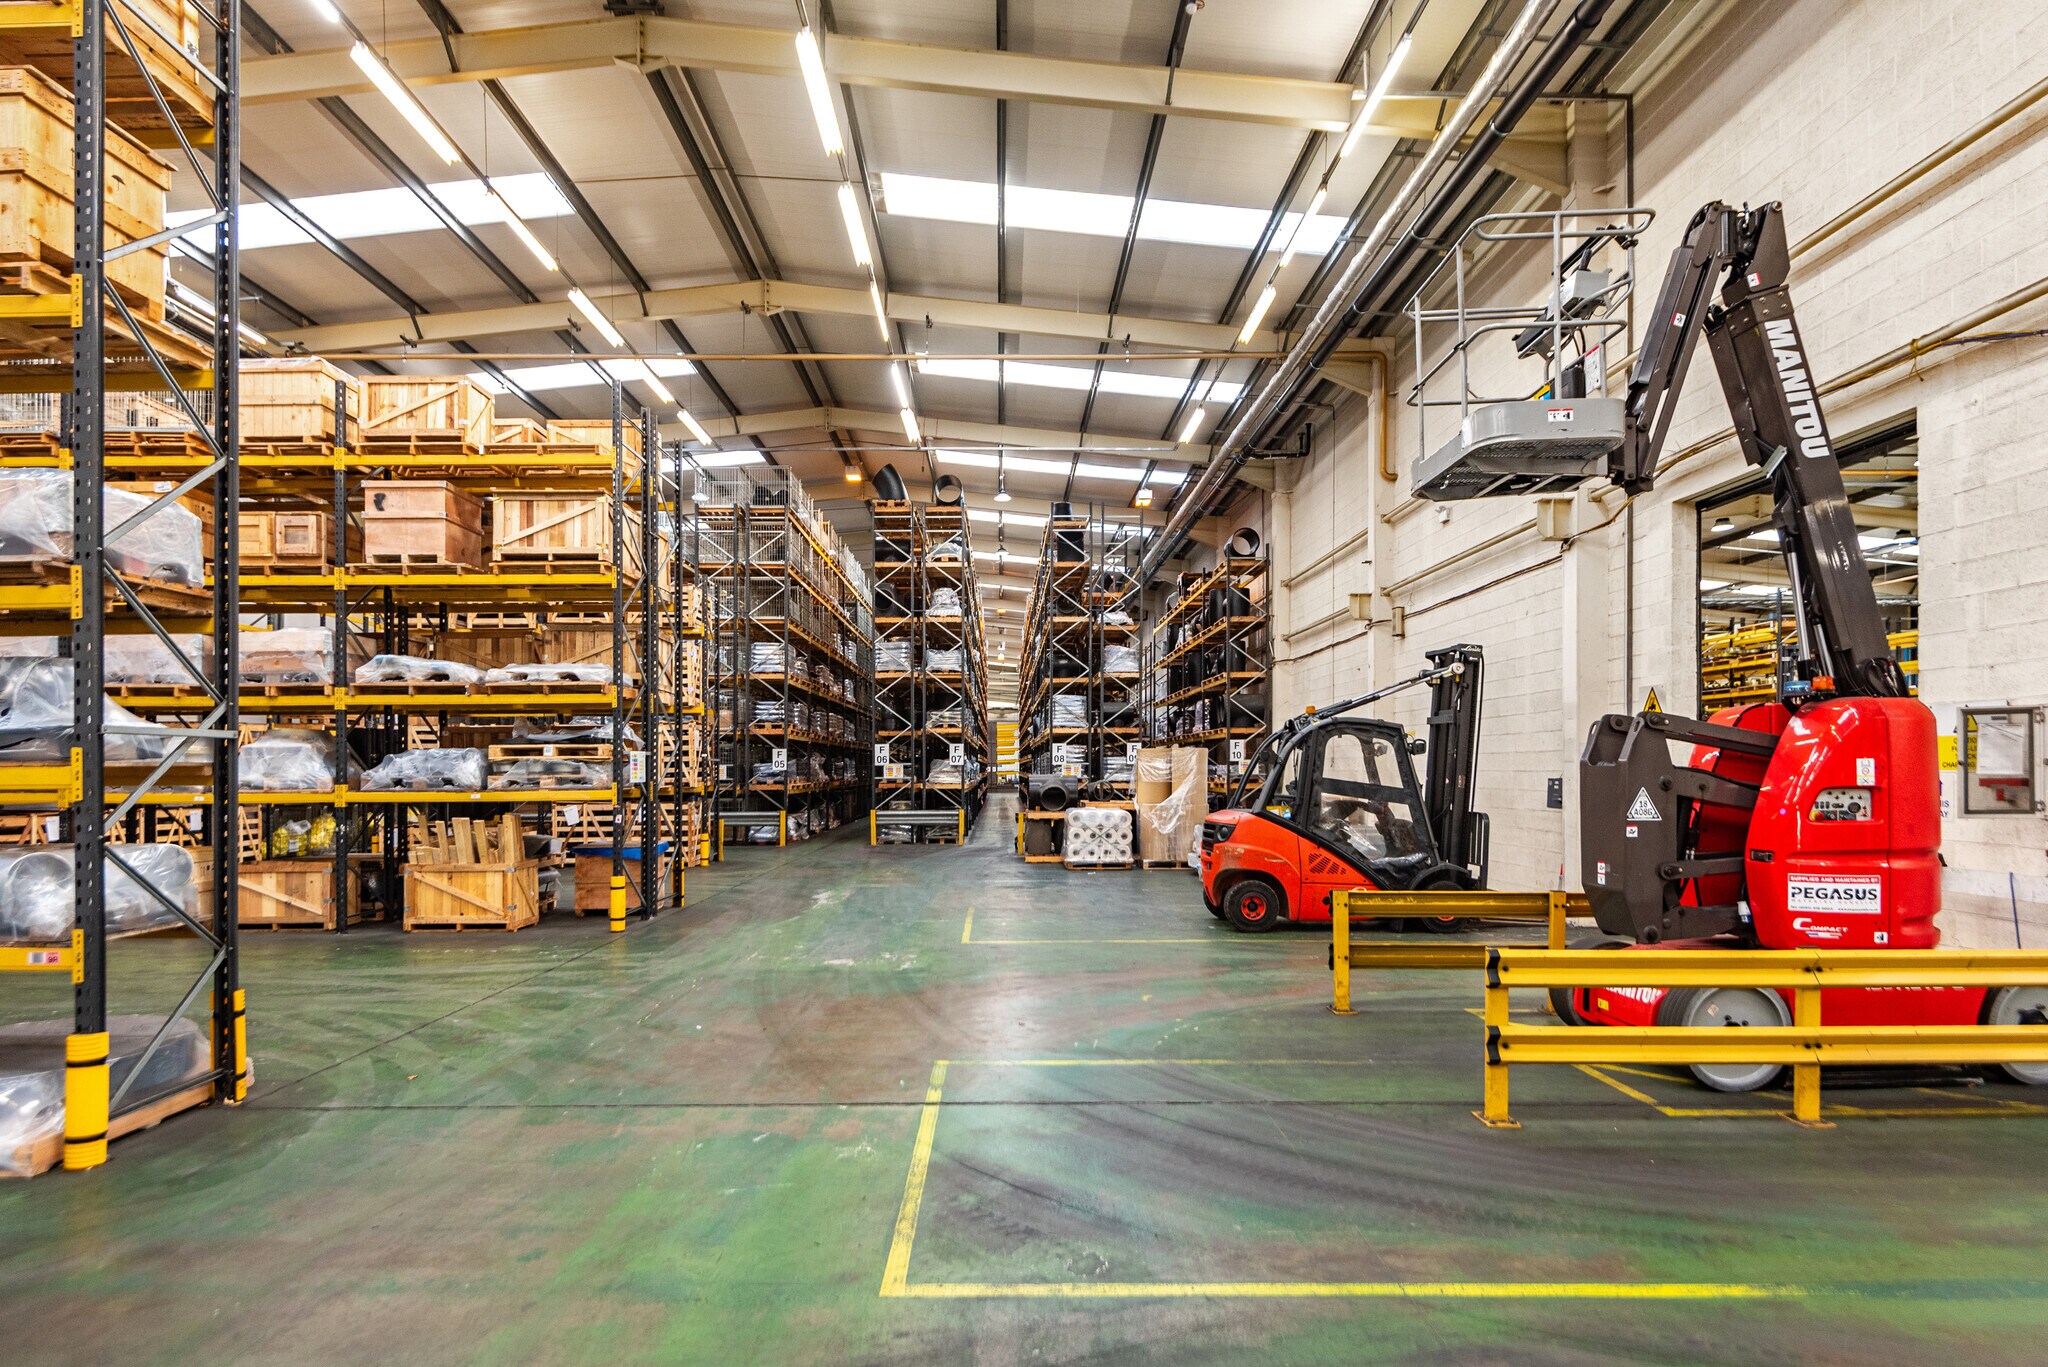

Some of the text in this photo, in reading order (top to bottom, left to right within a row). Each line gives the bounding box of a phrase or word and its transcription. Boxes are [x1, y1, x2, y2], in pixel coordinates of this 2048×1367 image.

[1764, 319, 1830, 459] MANITOU
[954, 745, 960, 753] F
[1056, 745, 1062, 753] F
[777, 750, 783, 758] F
[1232, 751, 1242, 759] 10
[876, 755, 888, 763] 06
[951, 755, 962, 763] 07
[1053, 754, 1065, 763] 08
[774, 760, 785, 768] 05
[1791, 886, 1877, 900] PEGASUS
